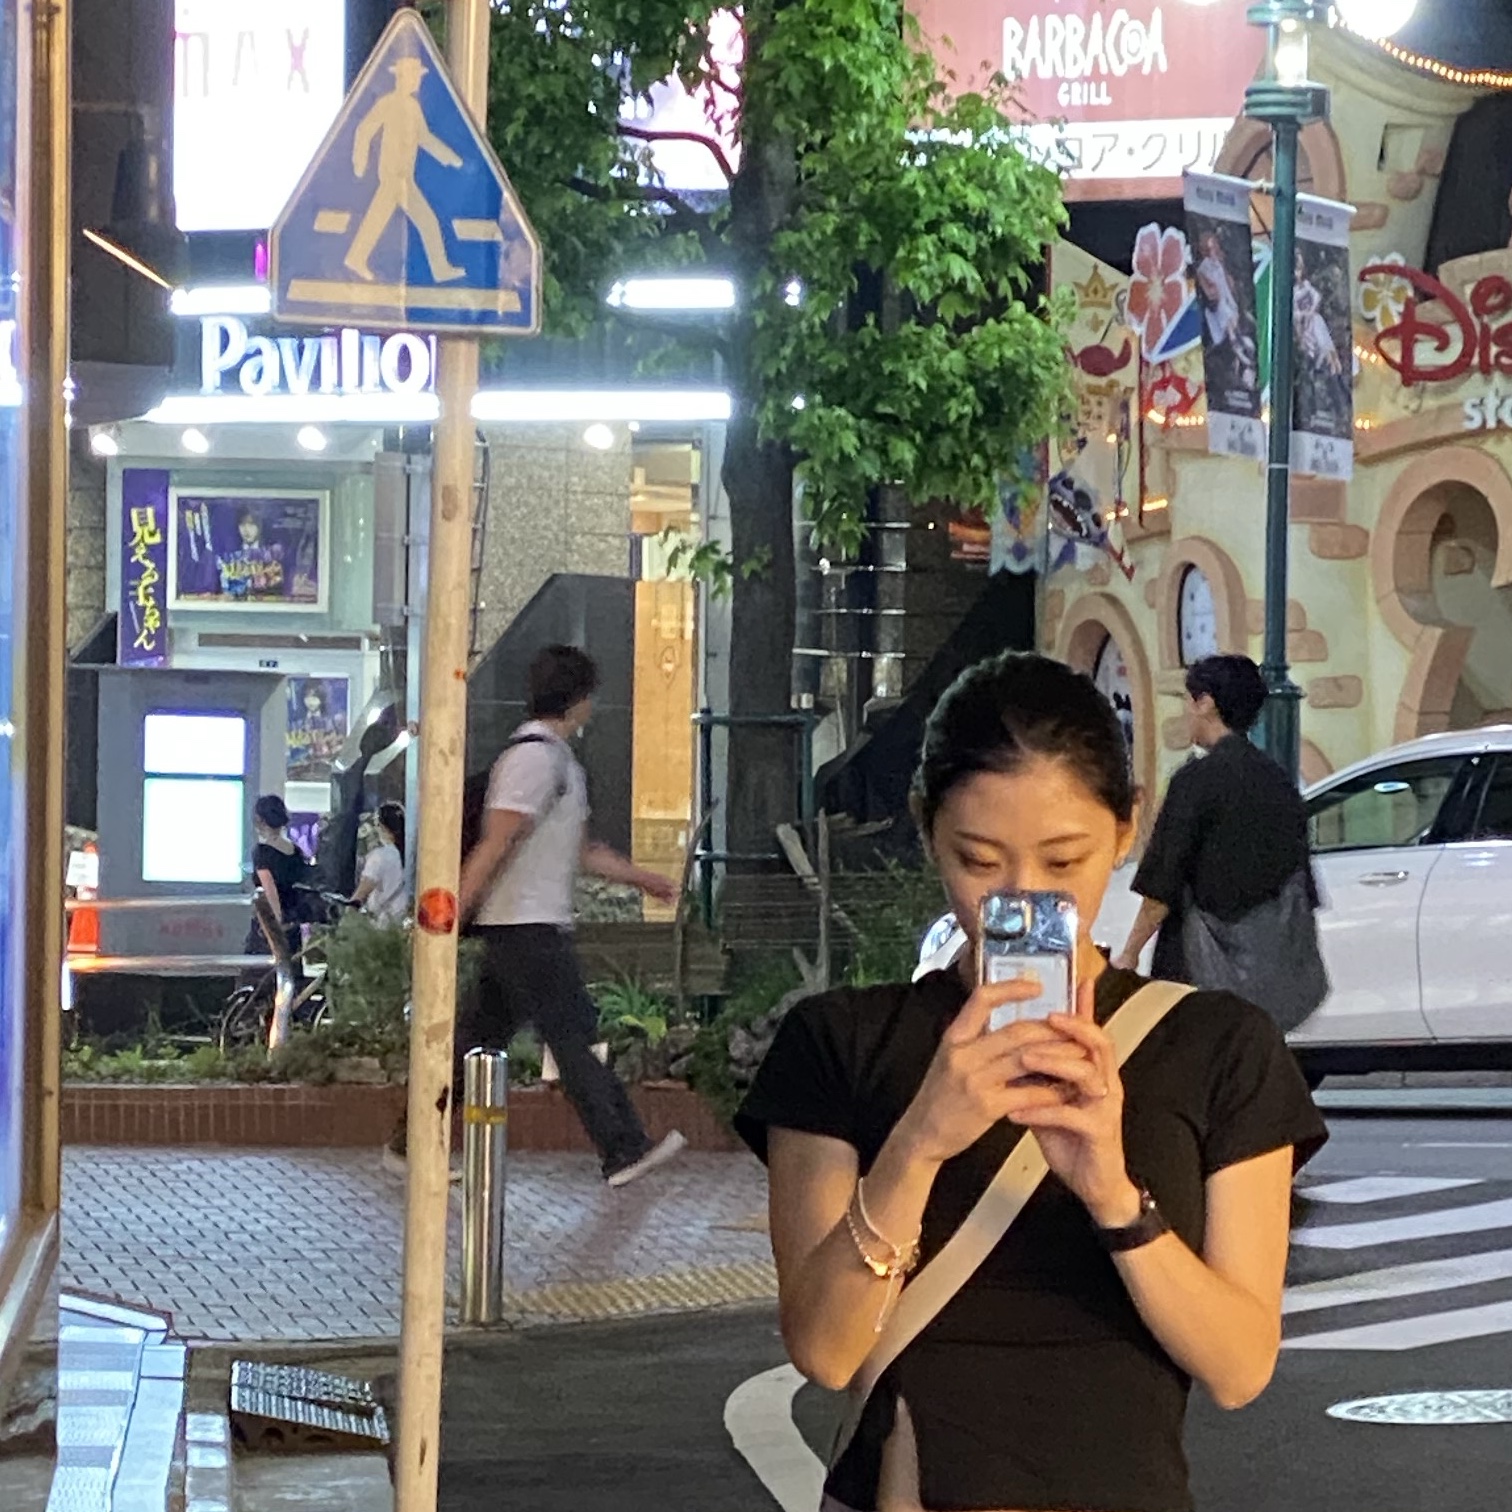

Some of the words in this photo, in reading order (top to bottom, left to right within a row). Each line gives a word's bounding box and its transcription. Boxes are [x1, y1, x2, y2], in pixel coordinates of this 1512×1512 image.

[1002, 7, 1167, 80] BARBACOA
[1058, 82, 1112, 107] GRILL
[200, 315, 437, 395] Pavilio
